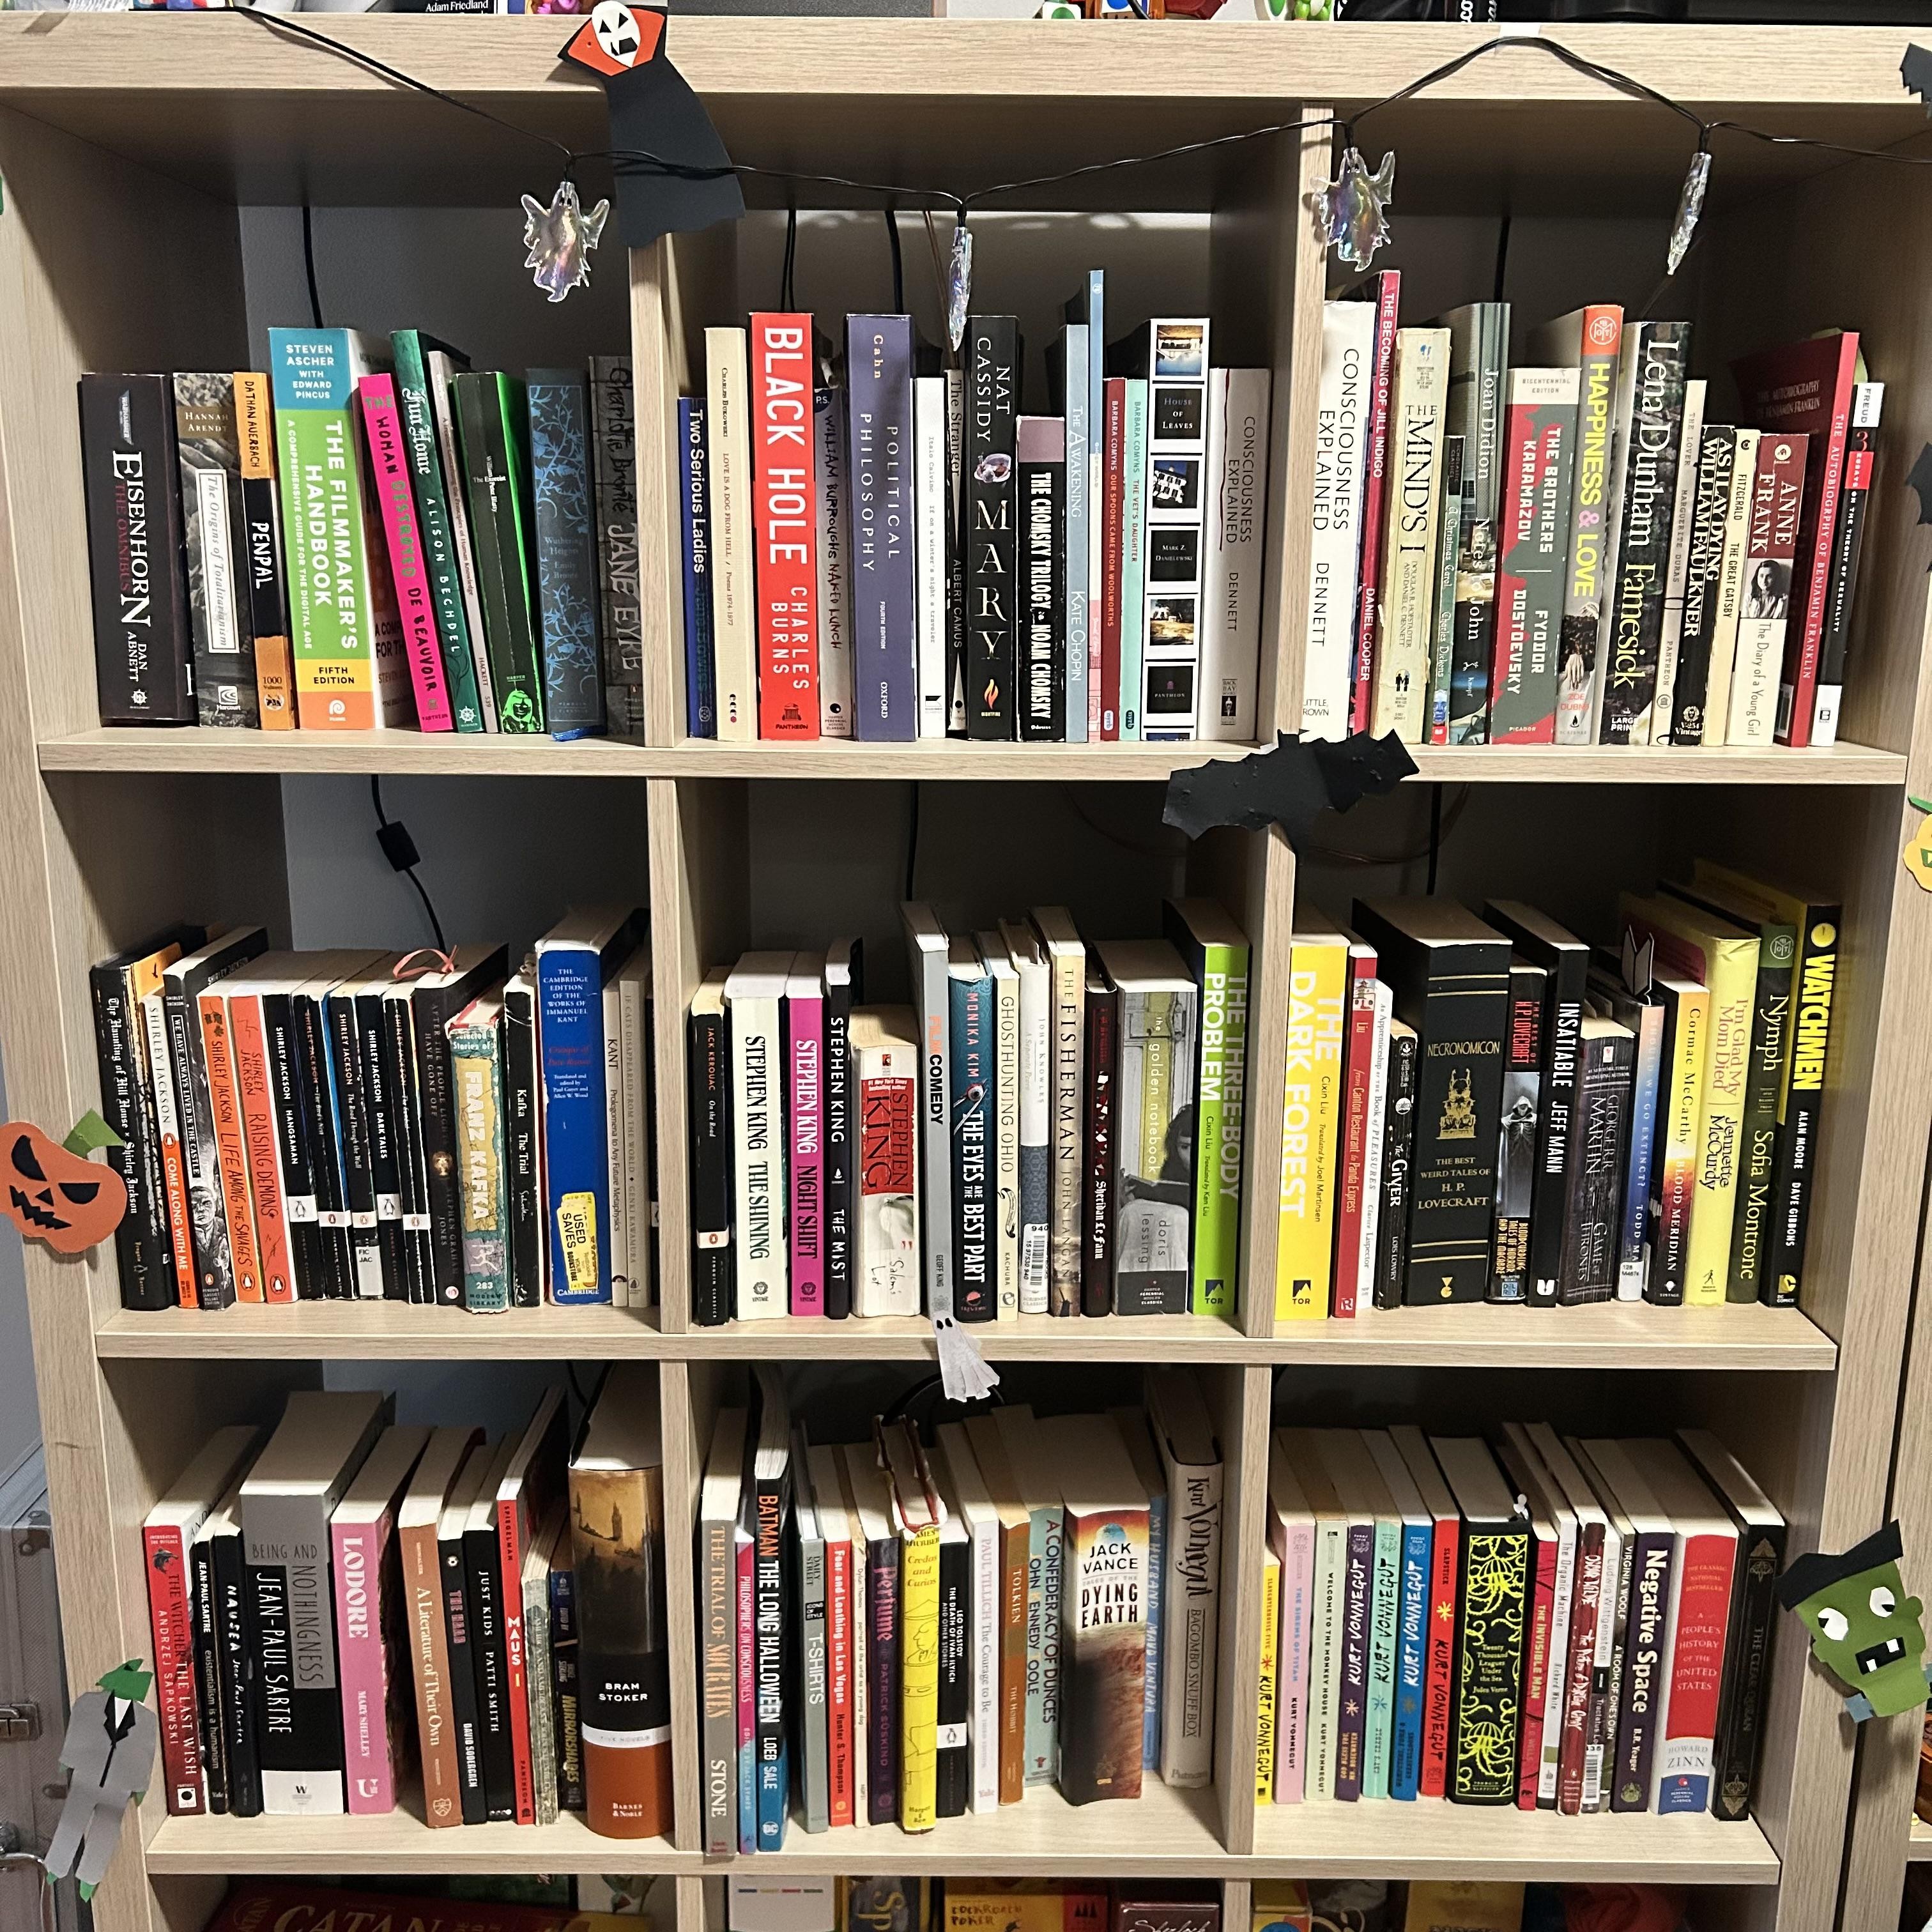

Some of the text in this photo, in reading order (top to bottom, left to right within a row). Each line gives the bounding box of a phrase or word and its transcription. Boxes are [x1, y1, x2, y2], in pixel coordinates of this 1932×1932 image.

[425, 1, 488, 12] Adam Friedland
[286, 345, 332, 355] STEVEN
[286, 356, 334, 366] ASCHER
[293, 381, 332, 389] EDWARD
[976, 337, 992, 443] CASSIDY
[995, 365, 1010, 415] NAT
[1406, 405, 1438, 416] THE
[763, 327, 808, 565] BLACK HOLE
[1579, 363, 1610, 505] HAPPINESS
[689, 410, 705, 573] Two Serious Ladies
[860, 413, 875, 572] PHILOSOPHY
[886, 425, 900, 558] POLITICAL
[1225, 459, 1238, 544] EXPLAINED
[1243, 416, 1255, 542] CONSCIOUSNESS
[1517, 440, 1537, 542] KARAMAZOV
[1540, 428, 1561, 554] THE BROTHERS
[1613, 339, 1678, 689] Lena Dunham Famesick
[1751, 473, 1775, 553] FRANK
[1774, 480, 1796, 546] ANNE
[252, 522, 273, 589] PENPAL
[305, 464, 333, 606] HANDBOOK
[325, 420, 357, 649] THE FILMMAKER'S
[1573, 534, 1598, 598] LOVE
[426, 497, 460, 652] ALISON BECHDEL
[1030, 472, 1052, 719] THE CHOMSKY TRILOGY NOAM CHOMSKY
[1228, 572, 1238, 632] DENNETT
[127, 632, 140, 682] ABNETT
[137, 643, 148, 671] DAN
[319, 666, 348, 675] FIFTH
[770, 602, 790, 675] BURNS
[790, 586, 809, 690] CHARLES
[1506, 589, 1527, 694] DOSTOEVSKY
[1531, 610, 1548, 675] FYODOR
[314, 676, 355, 684] EDITION
[607, 1039, 619, 1070] KANT
[1200, 972, 1225, 1101] PROBLEM
[1317, 992, 1344, 1061] THE
[1428, 1040, 1500, 1057] NECRONOMICON
[1793, 954, 1836, 1089] WATCHMEN
[276, 1026, 299, 1165] SHIRLEY JACKSON HANGSAMAN
[368, 1030, 387, 1159] SHIRLEY JACKSON DARK TALES
[930, 1054, 943, 1124] COMEDY
[1279, 971, 1317, 1218] DARK FOREST
[1545, 1002, 1580, 1175] INSATIABLE JEFF MANN
[516, 1089, 530, 1175] Kafka The Trial
[831, 1017, 845, 1282] STEPHEN KING THE MIST
[962, 1110, 984, 1183] THE EYES
[1436, 1156, 1476, 1167] THE BEST
[1740, 994, 1789, 1279] Nymph Sofia Montrone
[963, 1185, 972, 1199] THE
[973, 1185, 983, 1199] ARE
[1418, 1196, 1488, 1209] LOVECRAFT
[1421, 1170, 1448, 1178] WEIRD
[1450, 1169, 1476, 1177] TALES
[1786, 1110, 1809, 1246] ALAN MOORE DAVE GIBBONS
[562, 1213, 576, 1248] SAVES
[574, 1214, 586, 1244] USED
[963, 1204, 984, 1283] BEST PART
[252, 1543, 317, 1560] BEING AND
[342, 1537, 369, 1639] LODORE
[1083, 1558, 1138, 1574] VANCE
[1091, 1543, 1131, 1558] JACK
[1618, 1545, 1633, 1620] VIRGINIA WOOLF
[293, 1565, 324, 1684] NOTHINGNESS
[1082, 1583, 1138, 1608] DYING
[1082, 1607, 1138, 1629] EARTH
[1347, 1558, 1367, 1685] KURT VONNEGUT
[1403, 1560, 1425, 1687] KURT VONNEGUT
[1632, 1549, 1669, 1713] Negative Space
[256, 1573, 292, 1733] JEAN-PAUL SARTRE
[479, 1572, 498, 1733] JUST KIDS PATTI SMITH
[508, 1616, 521, 1666] MAUS
[758, 1495, 781, 1789] BATMAN THE LONG HALLOWEEN LOEB SALE
[808, 1634, 824, 1705] T-SHIRTS
[1531, 1604, 1546, 1700] THE INVISIBLE MAN
[710, 1760, 727, 1818] STONE
[1667, 1757, 1705, 1768] ZINN
